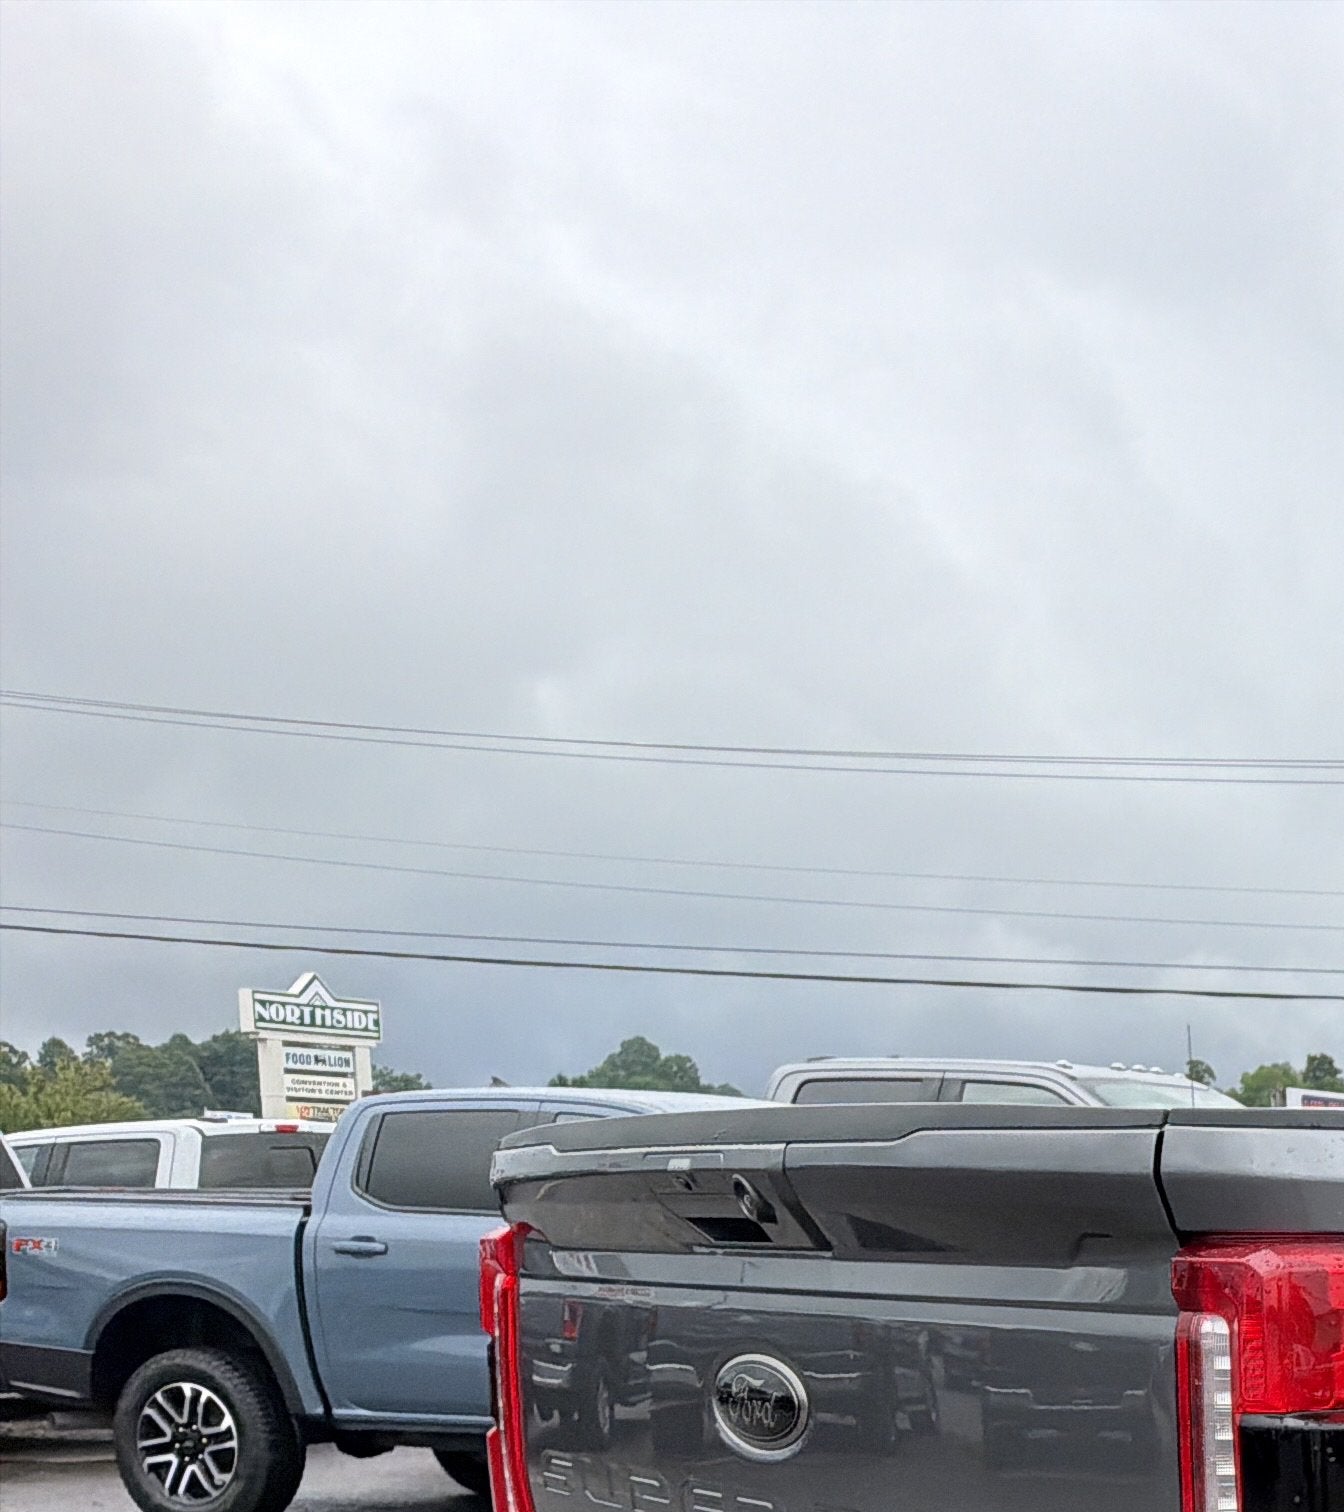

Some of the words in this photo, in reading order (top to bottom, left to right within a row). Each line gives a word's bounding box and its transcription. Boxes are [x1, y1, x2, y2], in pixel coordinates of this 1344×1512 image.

[254, 1000, 379, 1031] NORTHSIDE
[285, 1052, 312, 1066] FOOD
[327, 1053, 351, 1068] LION
[12, 1237, 59, 1257] FX4
[728, 1372, 779, 1428] Ford
